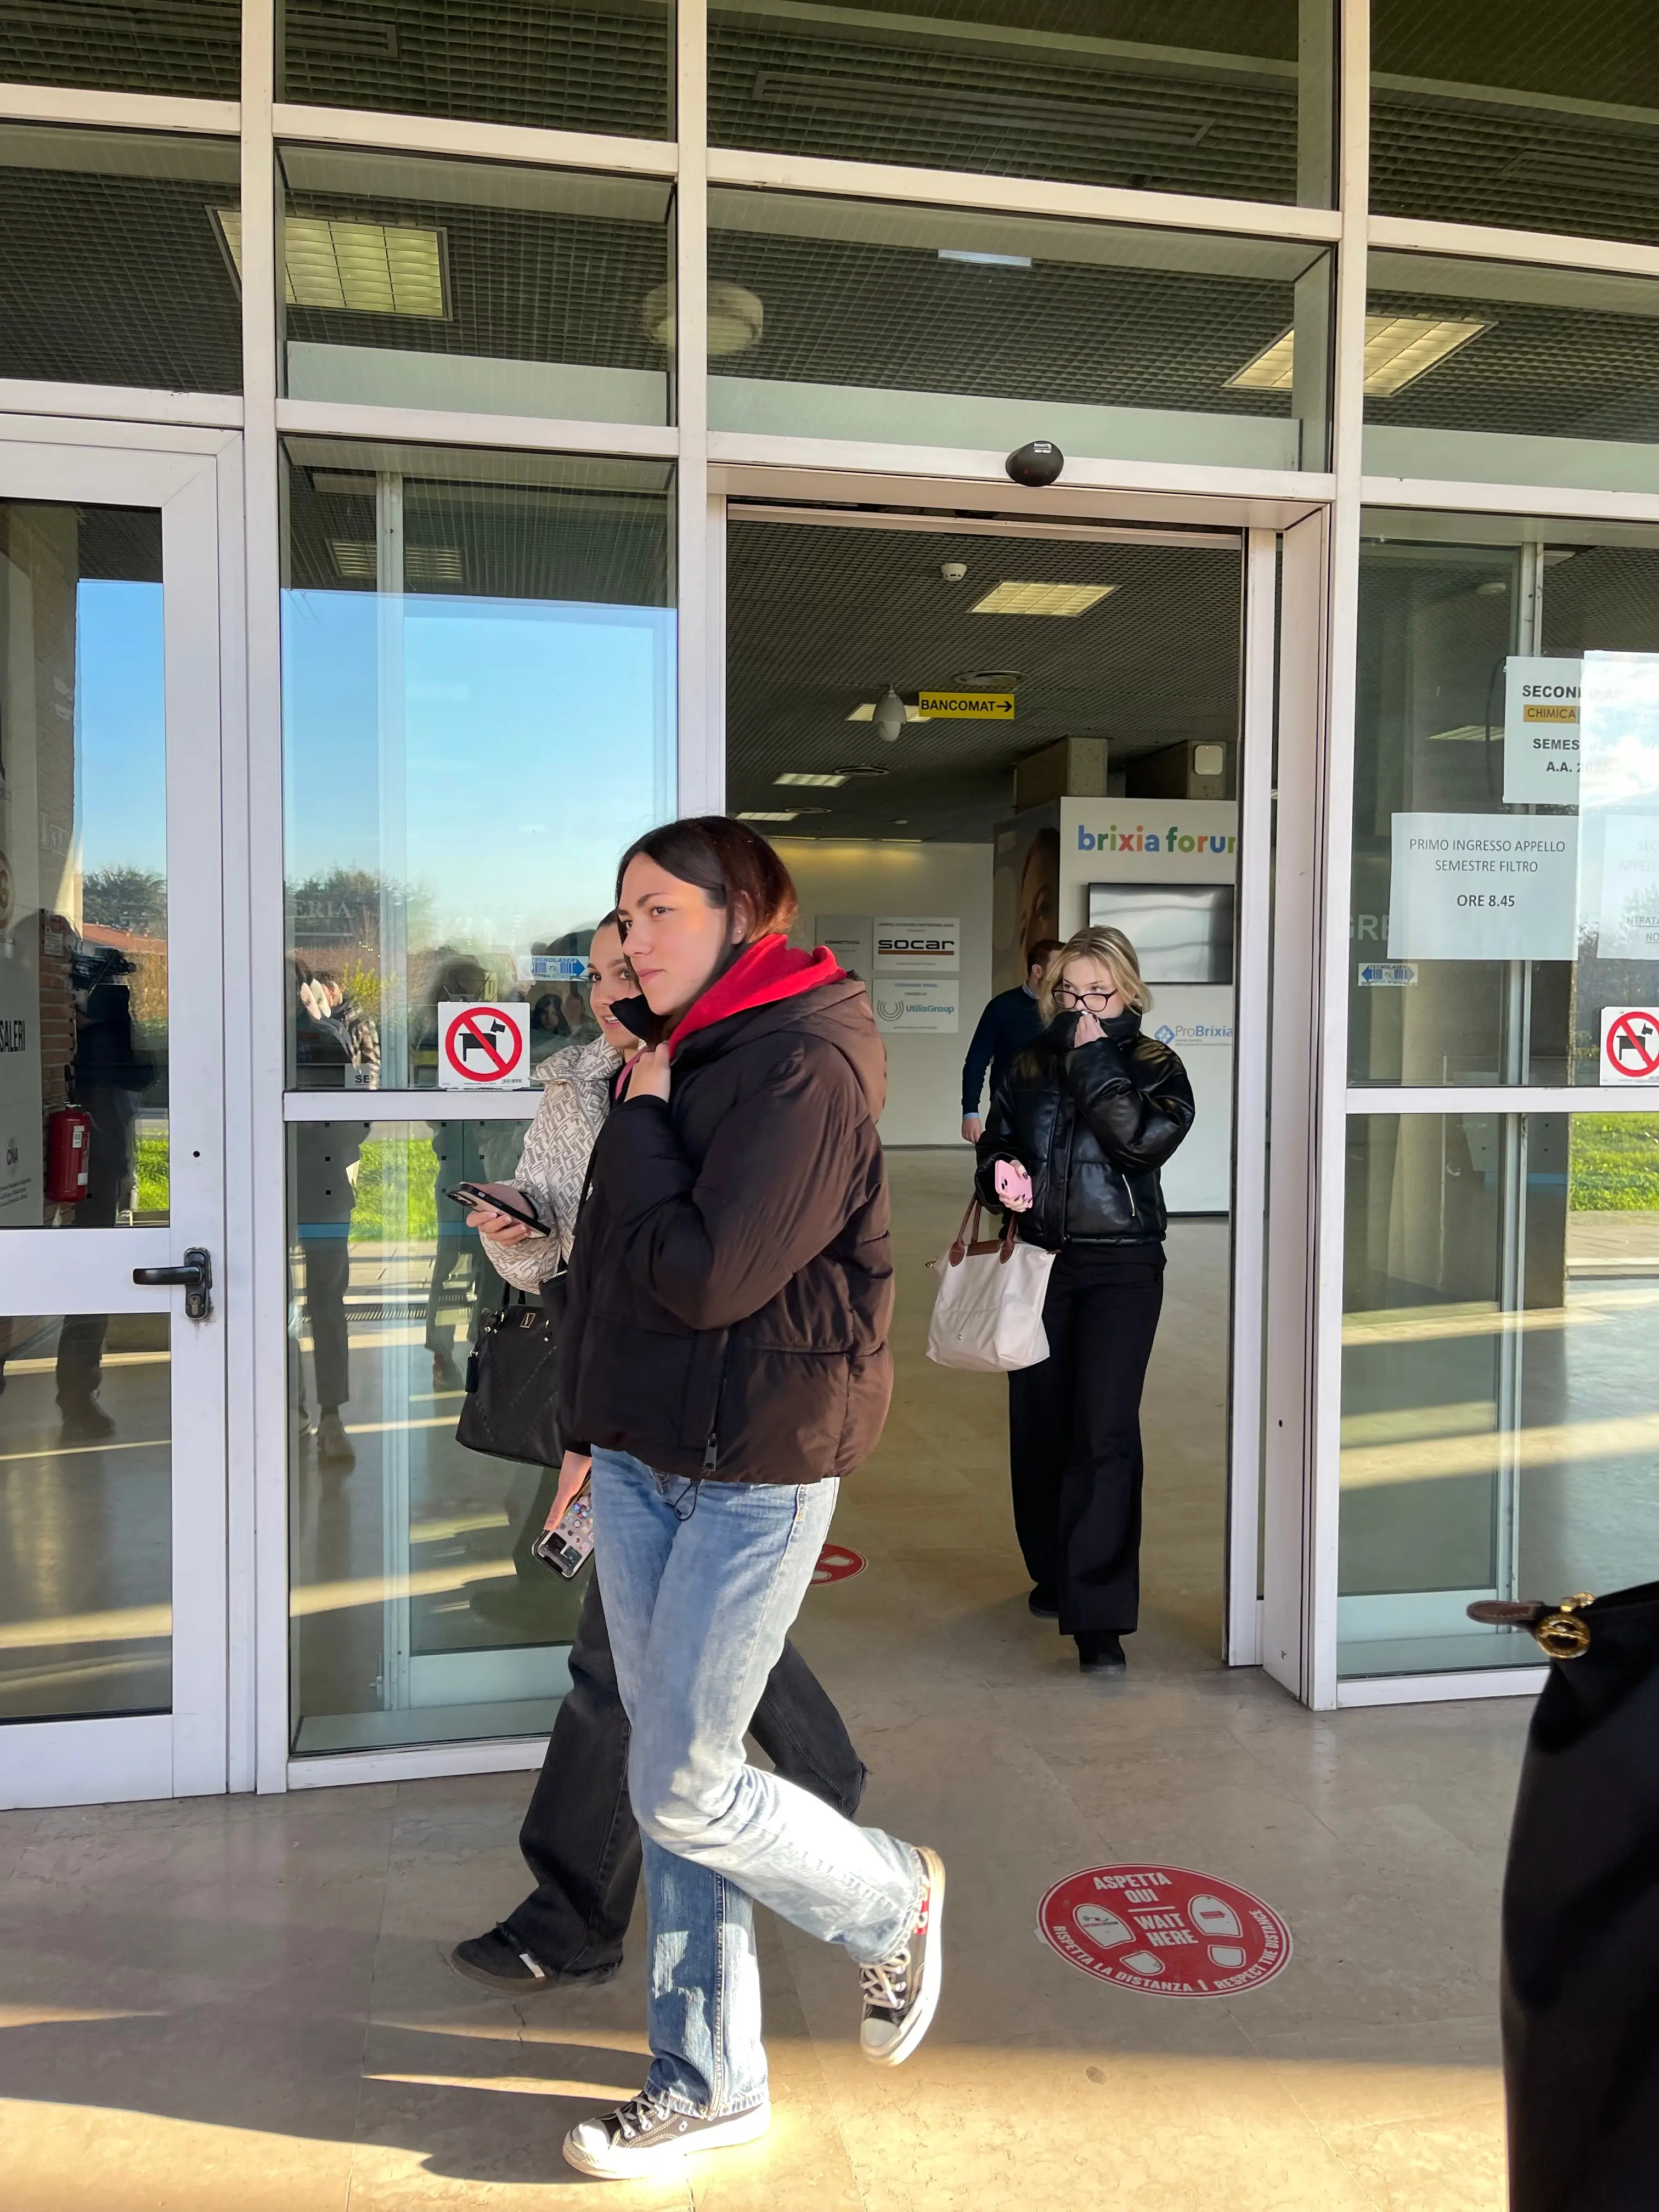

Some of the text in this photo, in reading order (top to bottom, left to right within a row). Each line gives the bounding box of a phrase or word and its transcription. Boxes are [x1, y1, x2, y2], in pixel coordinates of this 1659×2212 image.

[921, 699, 996, 712] BANCOMAT
[1527, 708, 1576, 719] CHIMICA
[1533, 738, 1580, 751] SEMES
[1546, 761, 1572, 772] A.A.
[1078, 825, 1160, 851] brixia
[1409, 839, 1565, 852] PRIMO INGRESSO APPELLO
[1435, 860, 1538, 872] SEMESTRE FILTRO
[1618, 860, 1659, 873] APPELL
[1457, 895, 1515, 907] ORE 8.45
[906, 1004, 955, 1014] UtilisGroup
[1175, 1025, 1233, 1037] ProBrixia
[1093, 1872, 1172, 1890] ASPETTA
[1124, 1888, 1159, 1902] QUI
[1133, 1913, 1185, 1930] WAIT
[1145, 1929, 1199, 1946] HERE
[1213, 1909, 1279, 1990] RESPECT THE DISTANCE
[1053, 1926, 1194, 1992] RISPETTA LA DISTANZA
